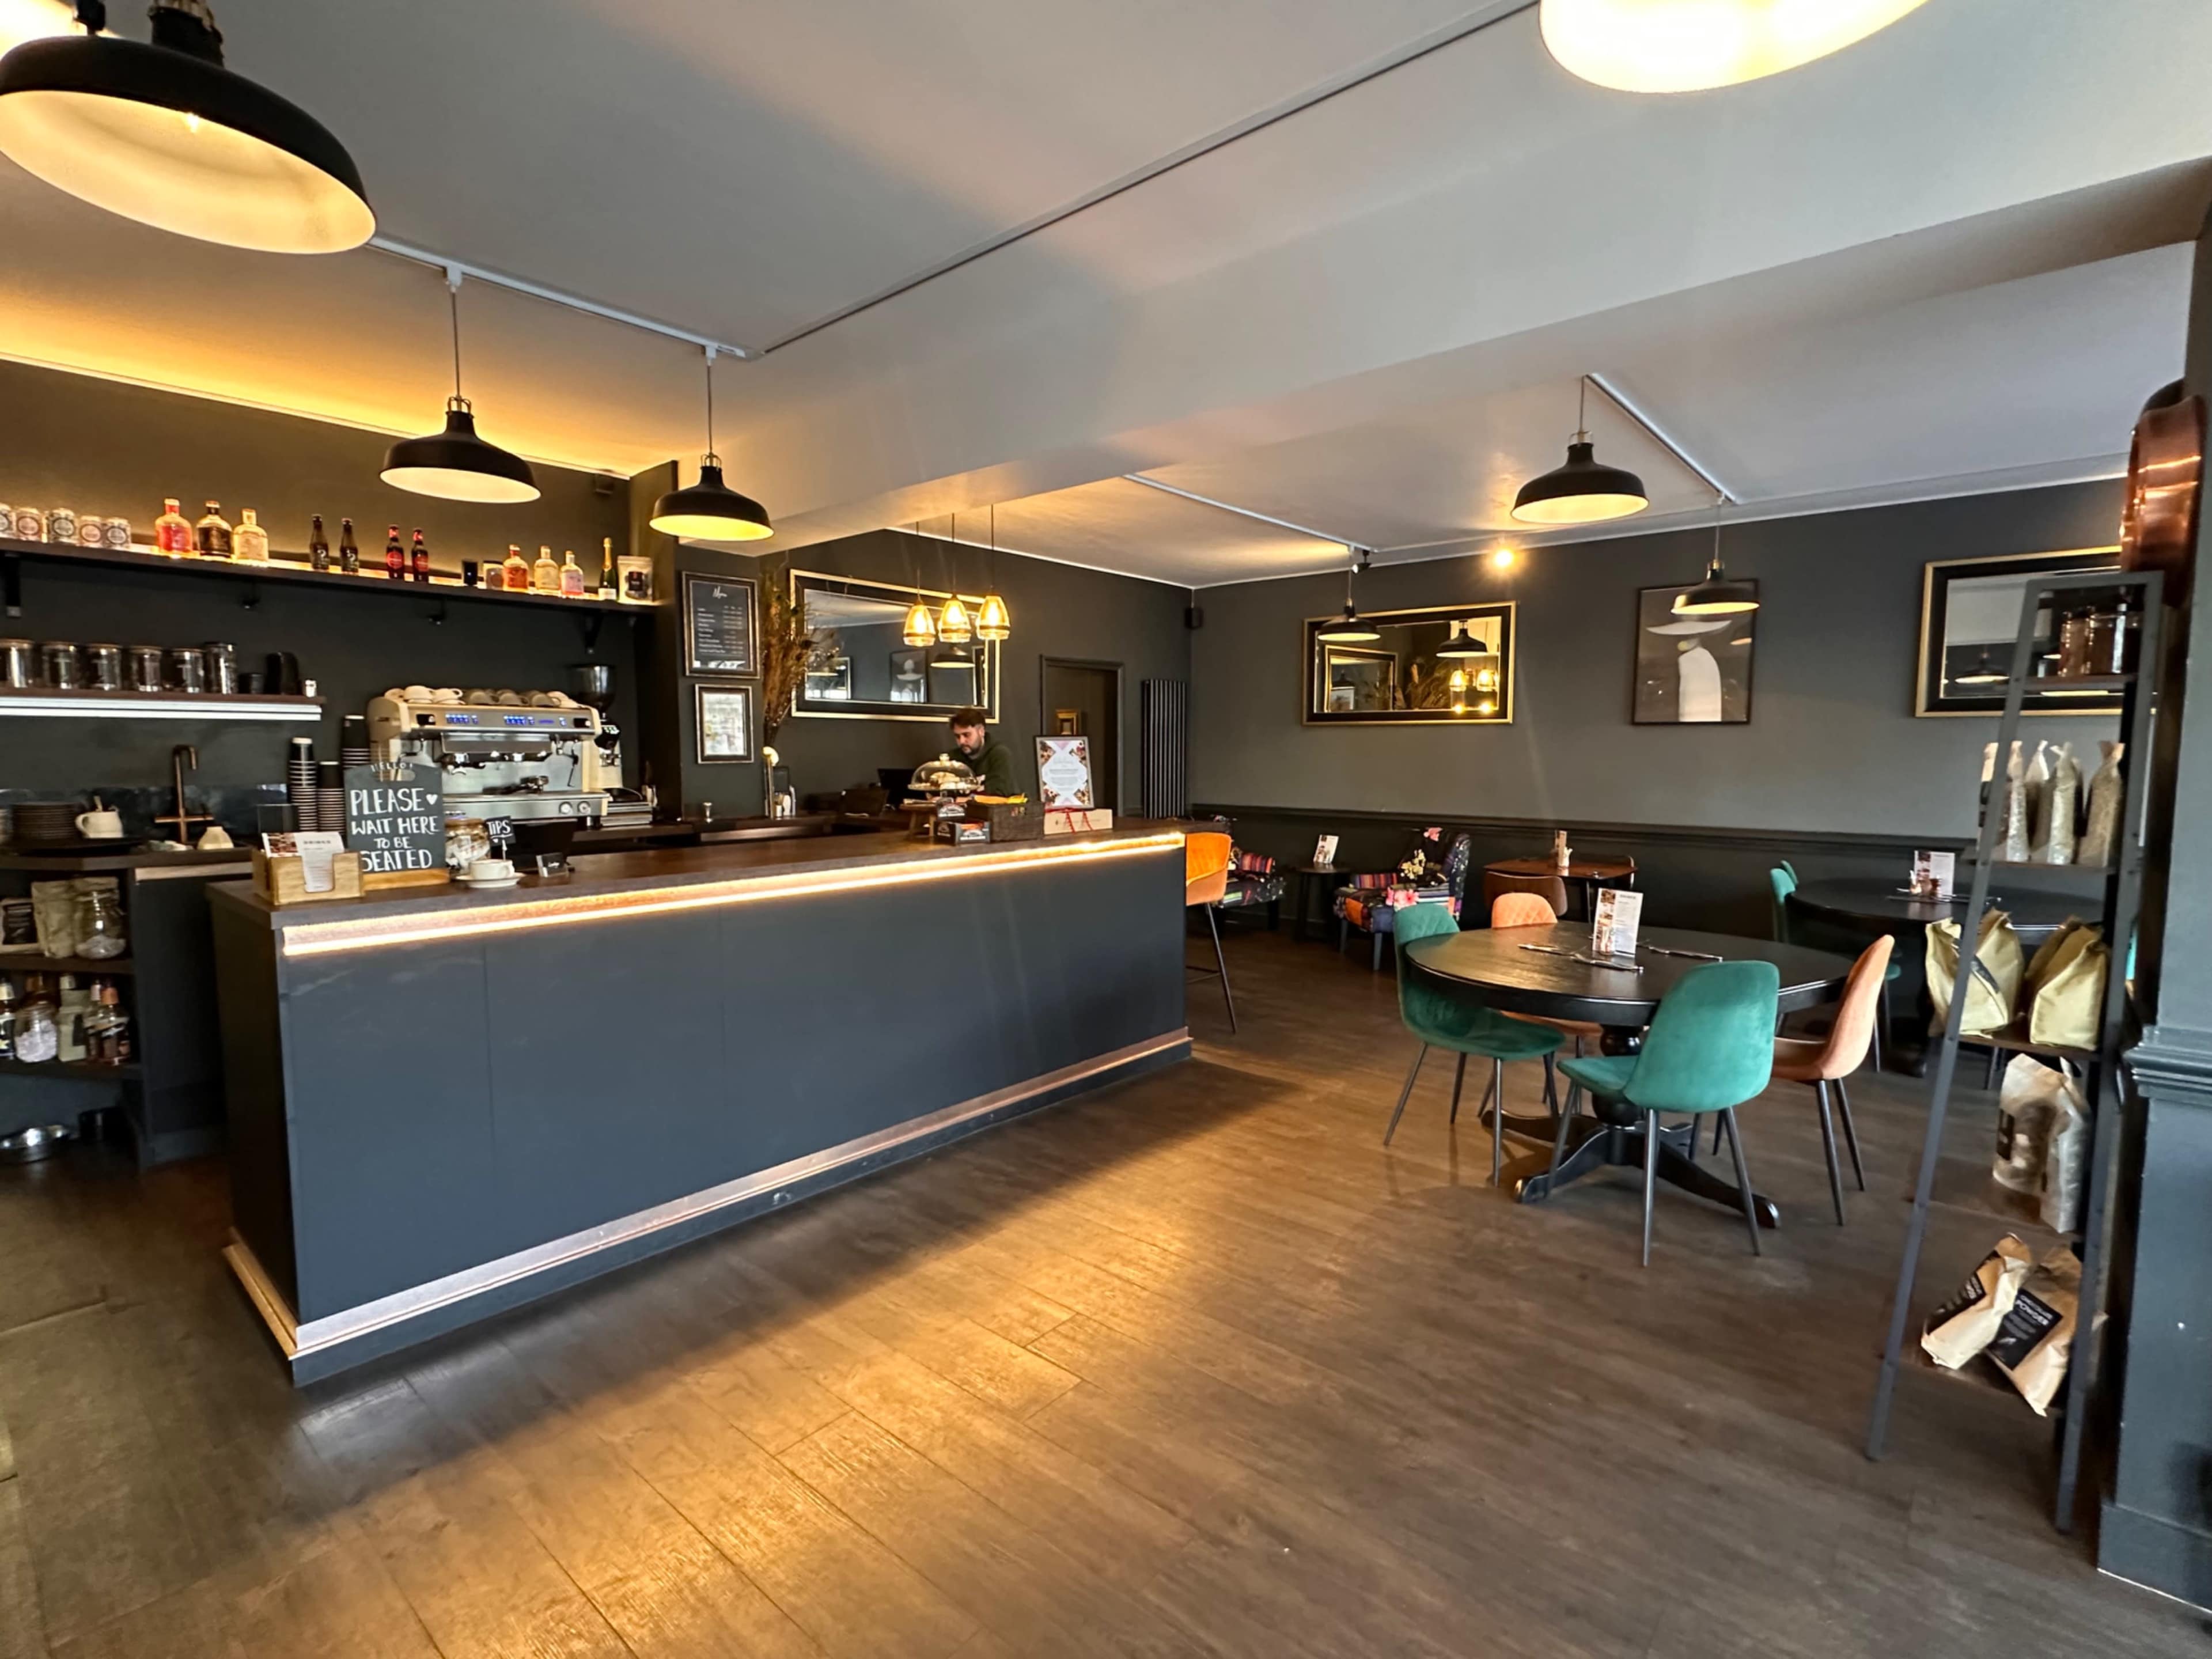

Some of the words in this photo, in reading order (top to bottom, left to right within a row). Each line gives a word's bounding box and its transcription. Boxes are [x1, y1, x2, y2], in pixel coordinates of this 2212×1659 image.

[350, 787, 425, 816] PLEASE
[351, 818, 393, 835] WAIT
[397, 816, 440, 835] HERE
[373, 837, 390, 849] TO
[393, 836, 413, 849] BE
[360, 849, 433, 872] SEATED
